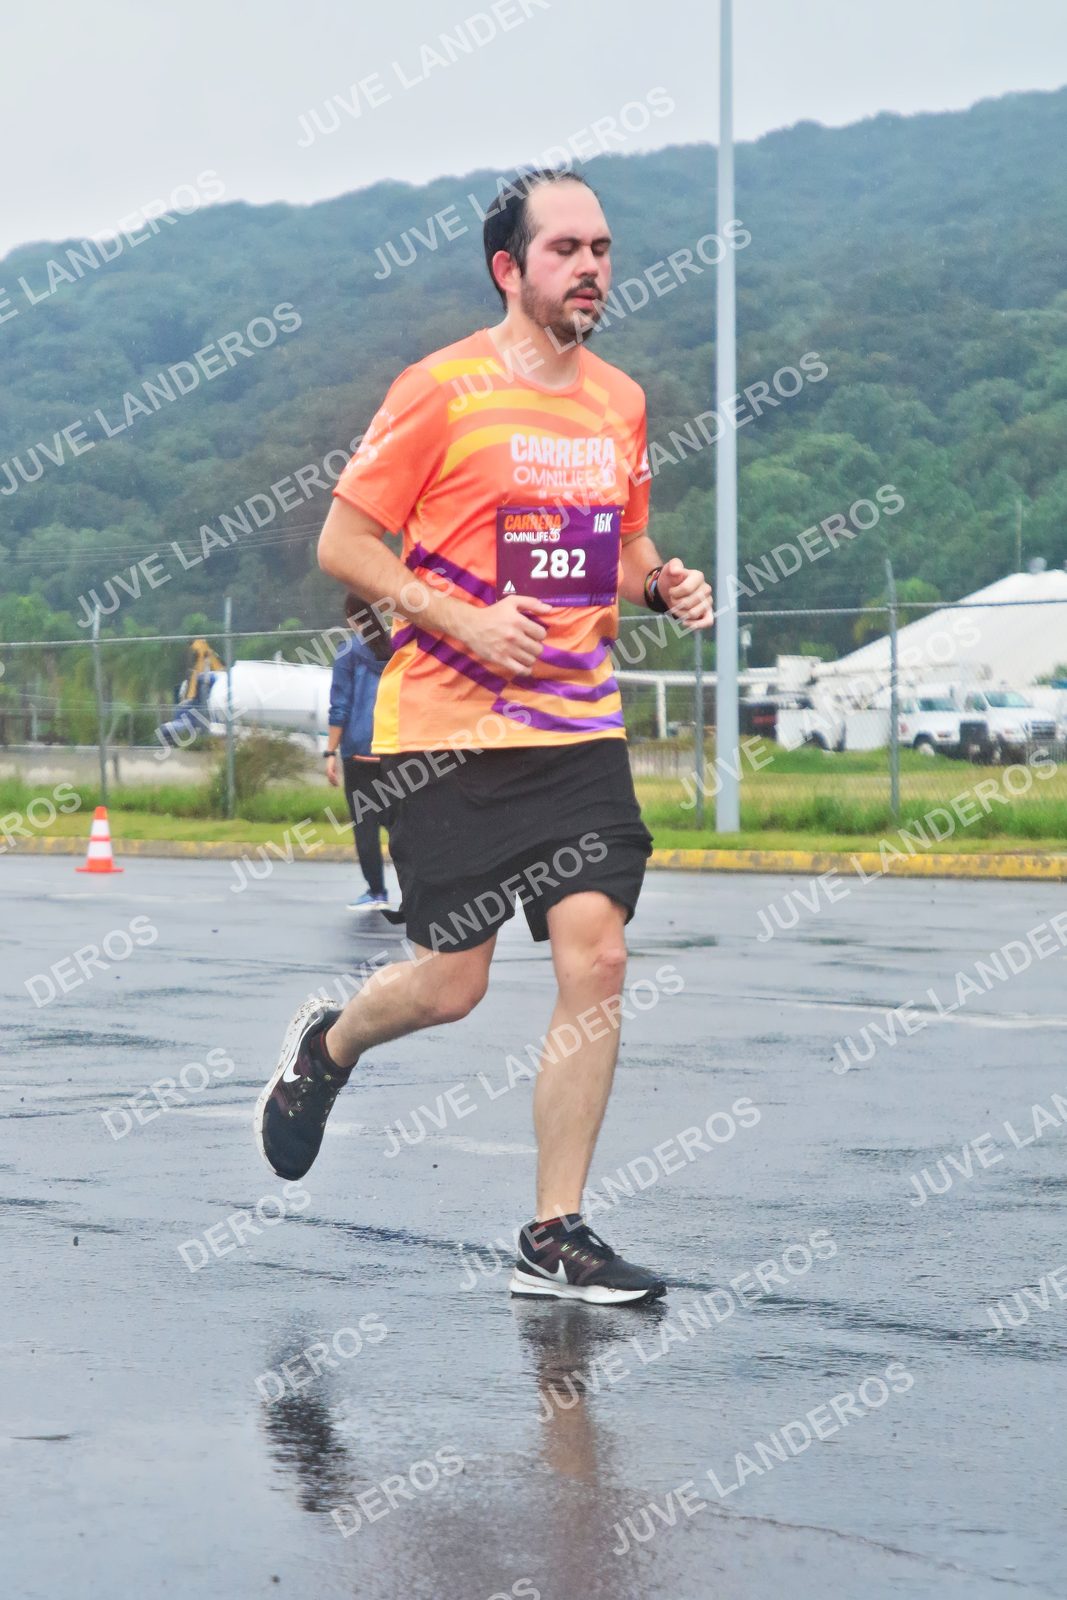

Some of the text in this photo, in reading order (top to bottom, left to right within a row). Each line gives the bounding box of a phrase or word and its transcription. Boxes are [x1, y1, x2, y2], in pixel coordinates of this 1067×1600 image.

[510, 433, 616, 467] CARRERA
[504, 514, 562, 530] CARRERA
[504, 531, 548, 543] OMNILIFE
[530, 548, 586, 579] 282
